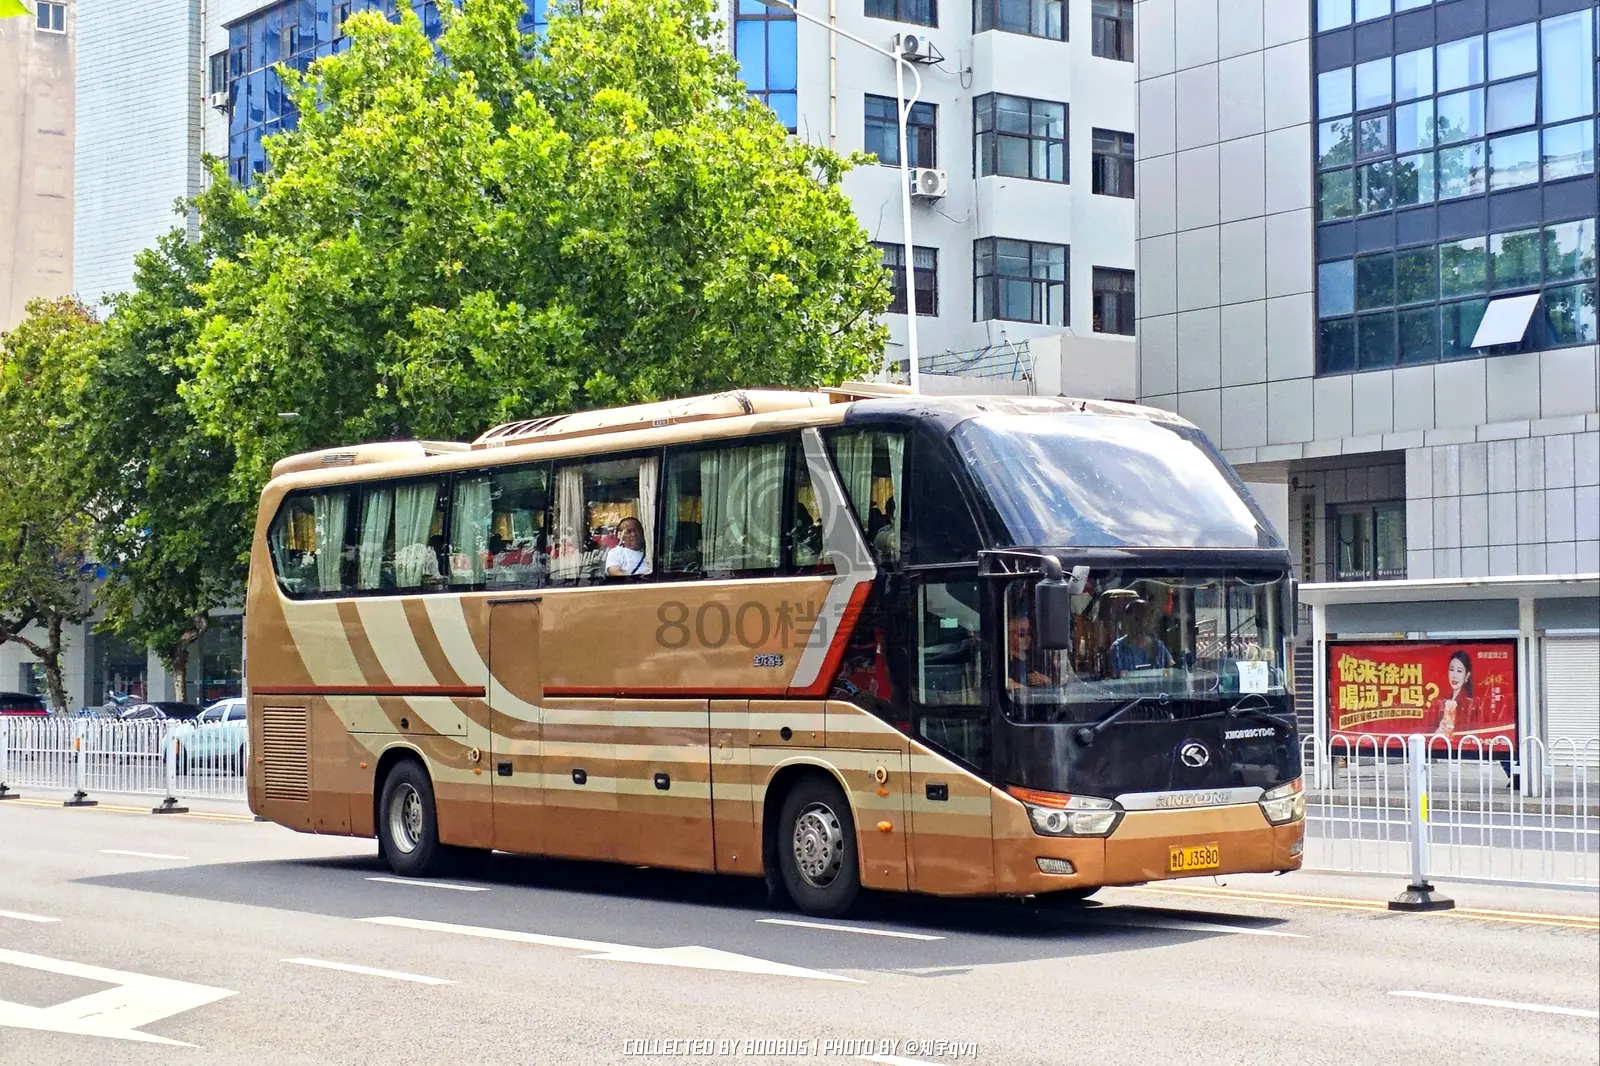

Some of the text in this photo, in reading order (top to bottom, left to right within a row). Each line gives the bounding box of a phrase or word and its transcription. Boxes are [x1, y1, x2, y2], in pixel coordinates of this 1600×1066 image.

[752, 653, 784, 668] 金龙客车
[1337, 653, 1423, 685] 你来徐州
[1338, 682, 1440, 711] 喝汤了吗?
